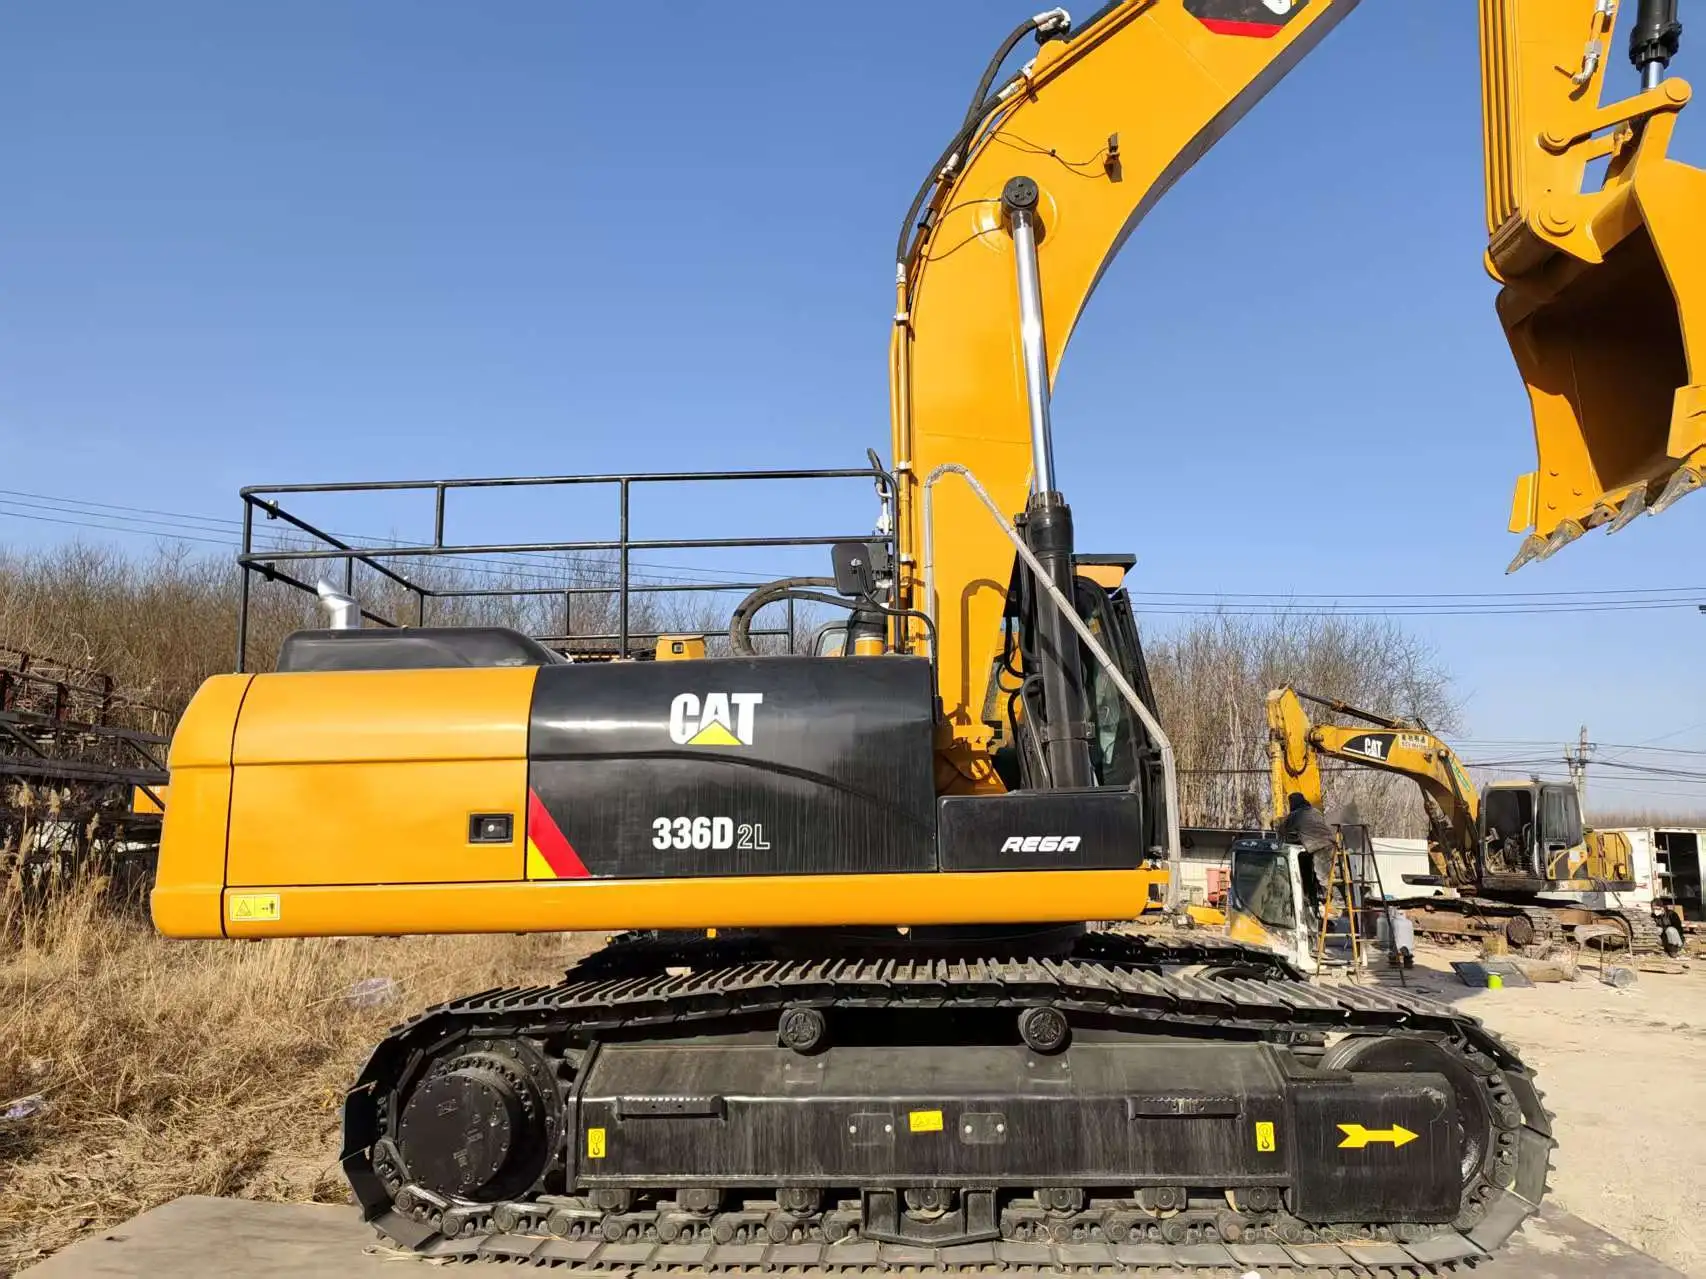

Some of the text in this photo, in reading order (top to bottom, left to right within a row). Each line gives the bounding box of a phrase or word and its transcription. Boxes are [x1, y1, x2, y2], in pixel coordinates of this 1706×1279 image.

[669, 692, 764, 746] CAT
[1364, 737, 1382, 758] CAT
[652, 816, 734, 850] 336D
[1000, 836, 1081, 853] REGA
